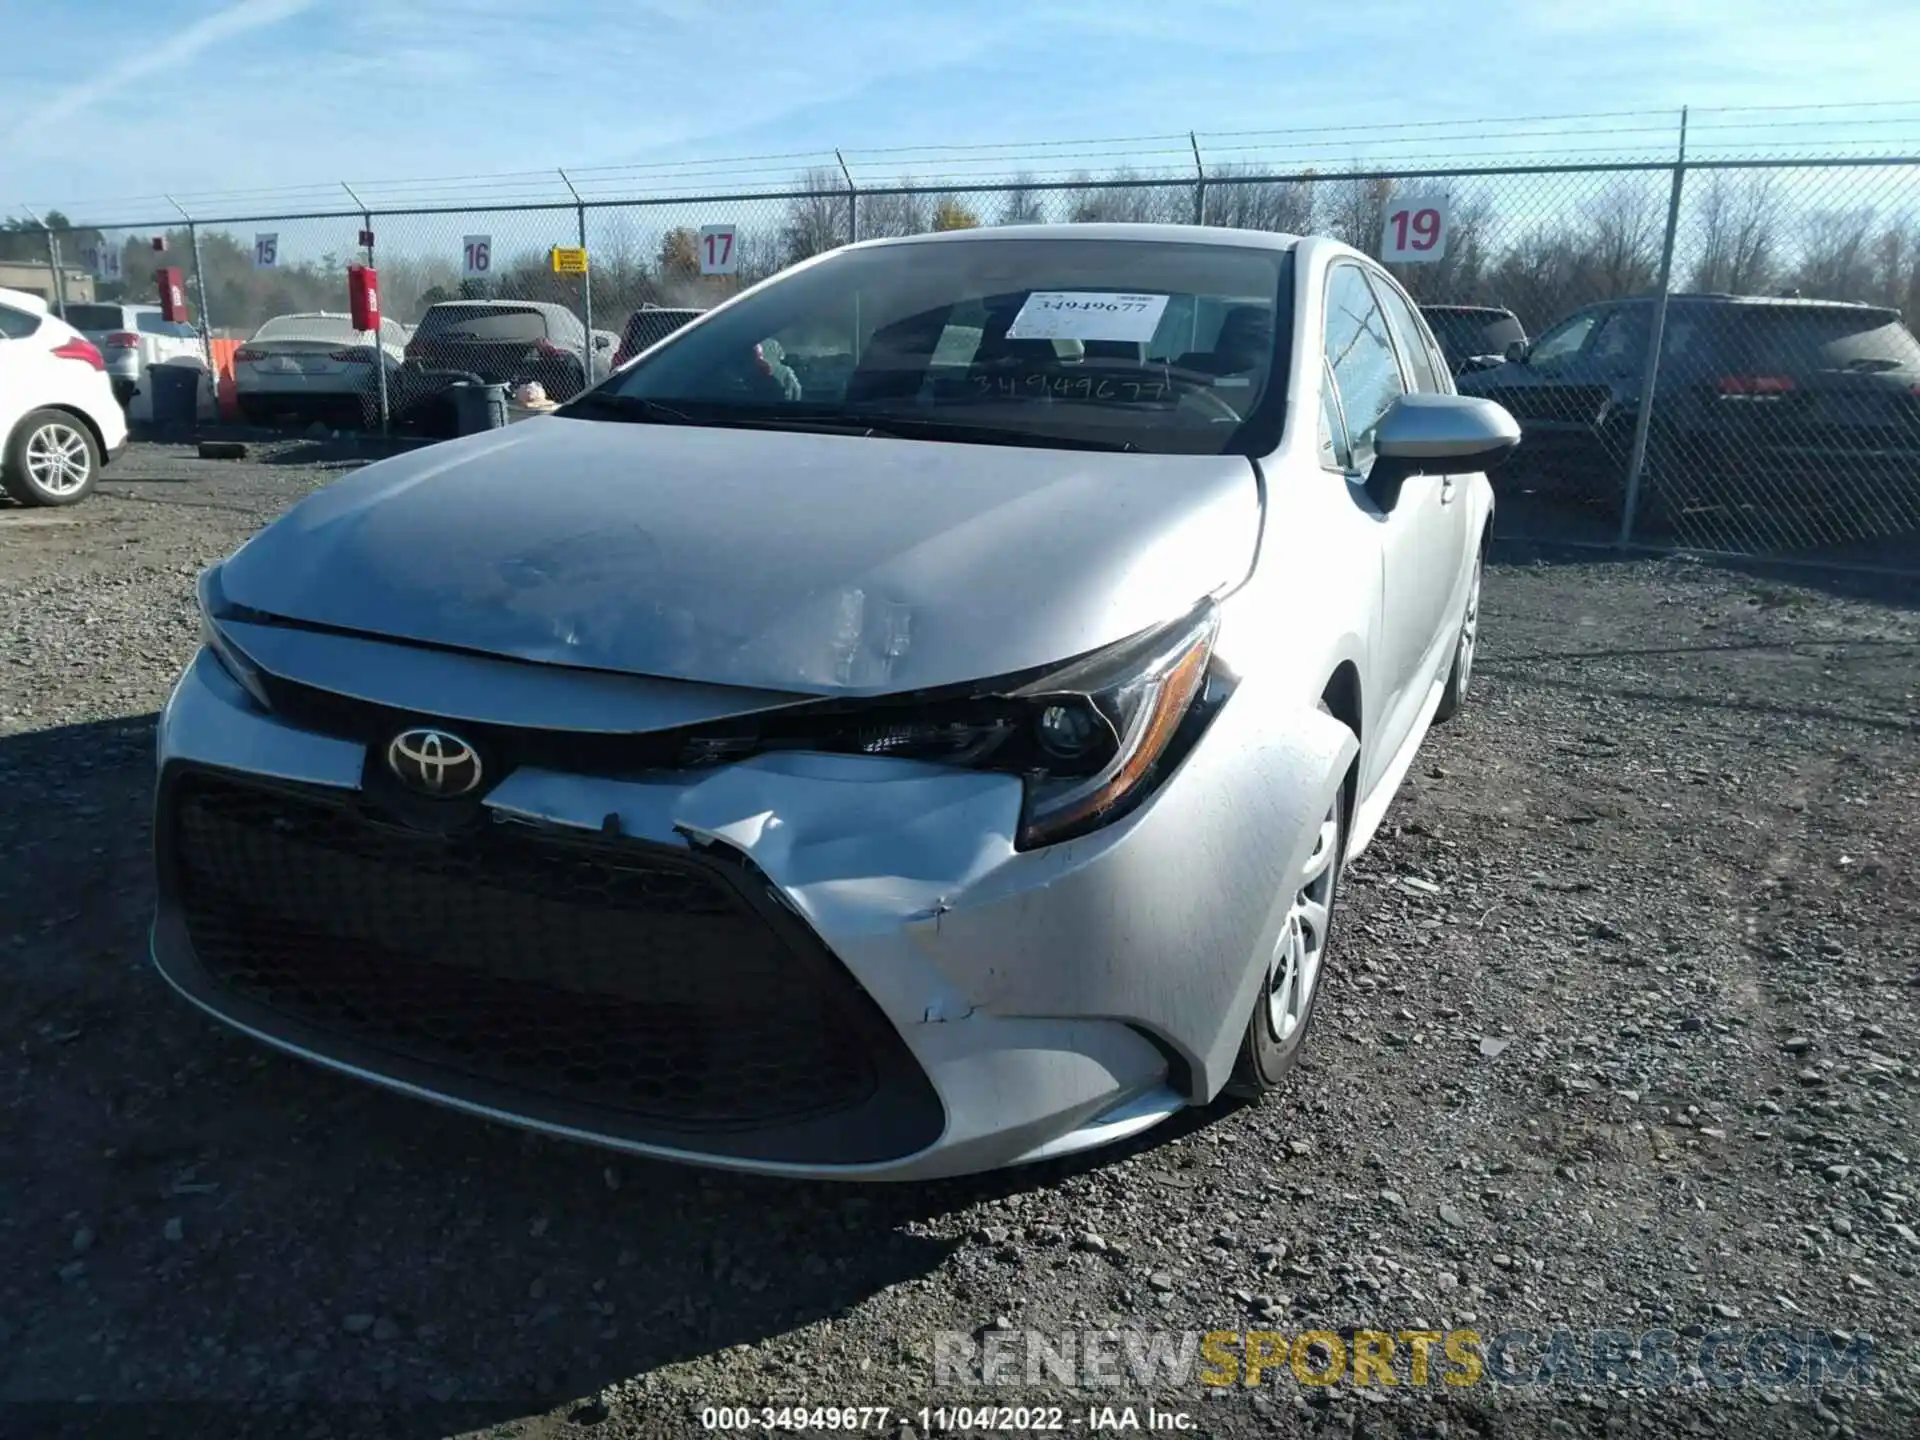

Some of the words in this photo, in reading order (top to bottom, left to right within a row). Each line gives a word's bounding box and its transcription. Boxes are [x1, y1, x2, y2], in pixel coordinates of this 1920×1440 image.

[1390, 208, 1441, 251] 19
[256, 240, 276, 265] 15
[465, 243, 489, 271] 16
[704, 233, 733, 265] 17
